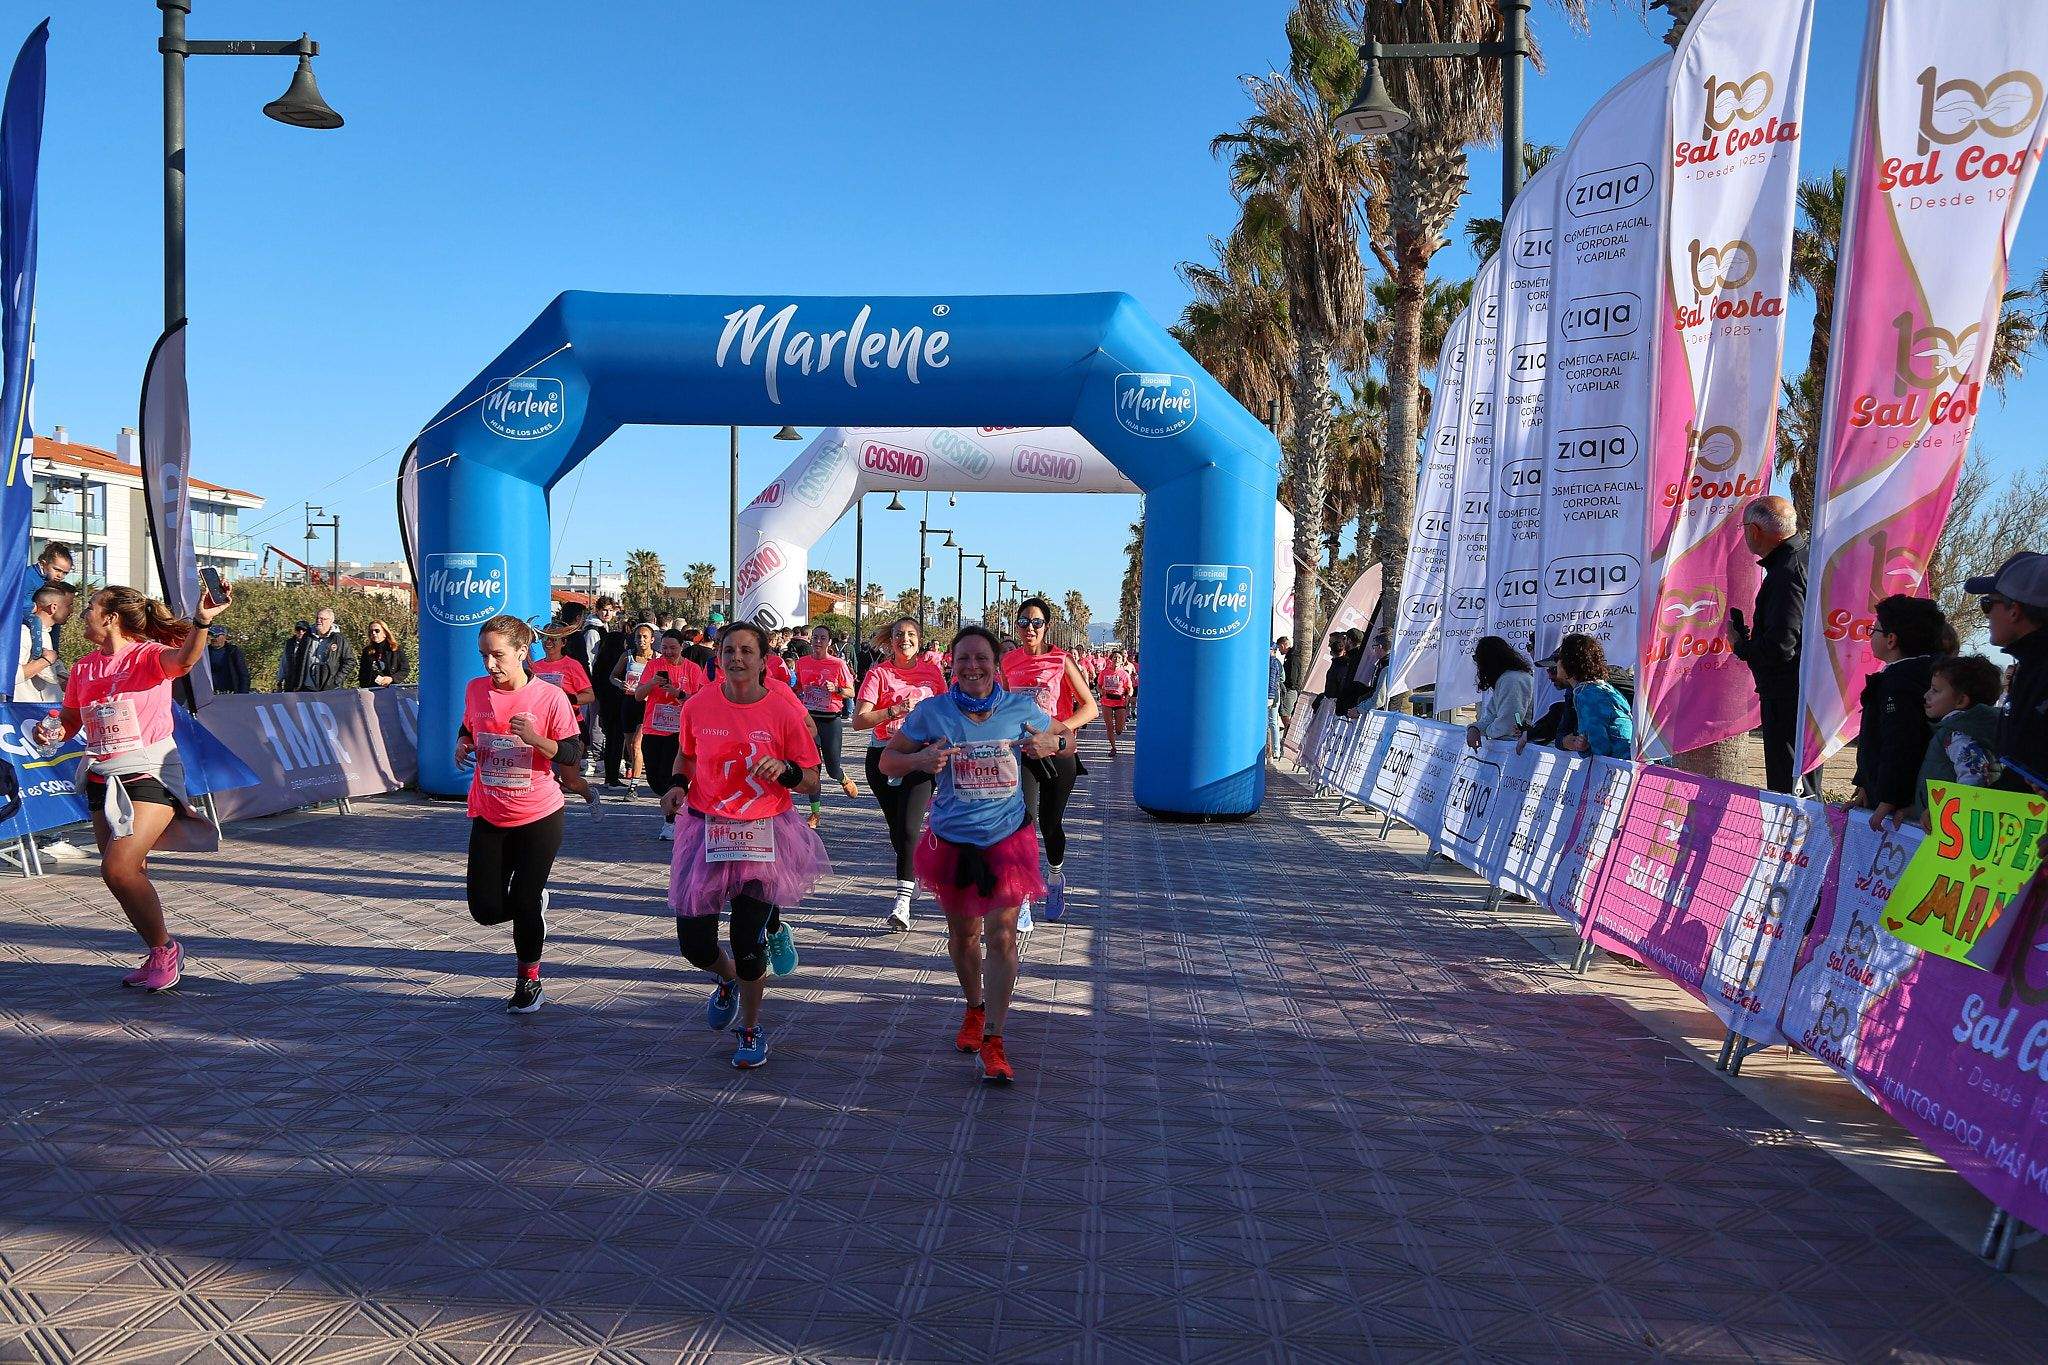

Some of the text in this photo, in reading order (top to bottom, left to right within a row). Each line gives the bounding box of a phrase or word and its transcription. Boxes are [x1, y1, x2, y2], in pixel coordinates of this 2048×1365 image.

[1675, 117, 1799, 168] Sal Costa
[1696, 165, 1735, 180] Desde
[1877, 145, 2026, 191] Sal Cos
[1576, 174, 1640, 205] ziaja
[1910, 187, 2013, 210] Desde 19
[1576, 234, 1629, 252] CORPORAL
[1576, 248, 1626, 265] Y CAPILAR
[1674, 300, 1705, 331] Sal
[1720, 325, 1751, 337] 1925
[1566, 366, 1622, 380] CORPORAL
[1568, 380, 1620, 394] Y CAPILAR
[1850, 393, 1920, 428] Sal
[490, 419, 504, 432] HIJA
[505, 427, 516, 435] DE
[532, 422, 553, 435] ALPES
[1125, 419, 1139, 432] HIJA
[1166, 419, 1186, 433] ALPES
[1557, 437, 1625, 464] ziaja
[1887, 435, 1943, 449] Desde
[865, 444, 924, 478] COSMO
[932, 429, 989, 475] COSMO
[1017, 449, 1077, 481] COSMO
[1511, 469, 1541, 486] zia
[1551, 482, 1602, 497] OSMÉTICA
[1563, 496, 1621, 509] CORPORAL
[1705, 504, 1734, 515] 1925
[1563, 509, 1619, 522] Y CAPILAR
[737, 546, 782, 596] COSMO
[1554, 565, 1627, 591] ziaja
[1503, 580, 1538, 597] zia
[431, 604, 444, 617] HIJA
[444, 613, 455, 621] DE
[472, 605, 495, 620] ALPES
[1543, 609, 1601, 624] COSMÉTICA
[1174, 616, 1189, 631] HIJA
[1219, 619, 1241, 635] ALPES
[1824, 608, 1874, 642] Sa
[702, 728, 729, 737] OYSHO
[493, 757, 514, 768] 016
[975, 766, 999, 776] 016
[28, 785, 42, 796] es
[729, 831, 754, 840] 016
[1937, 797, 2044, 872] SUPE
[1625, 854, 1654, 891] Sal
[1650, 944, 1699, 983] MOMENTOS
[1826, 950, 1846, 973] Sal
[1845, 958, 1875, 987] Costa
[1951, 993, 2019, 1059] Sal
[1801, 1029, 1819, 1052] Sal
[1968, 1065, 2022, 1108] Desde
[1943, 1110, 1983, 1152] POR
[1985, 1136, 2026, 1179] MÁS
